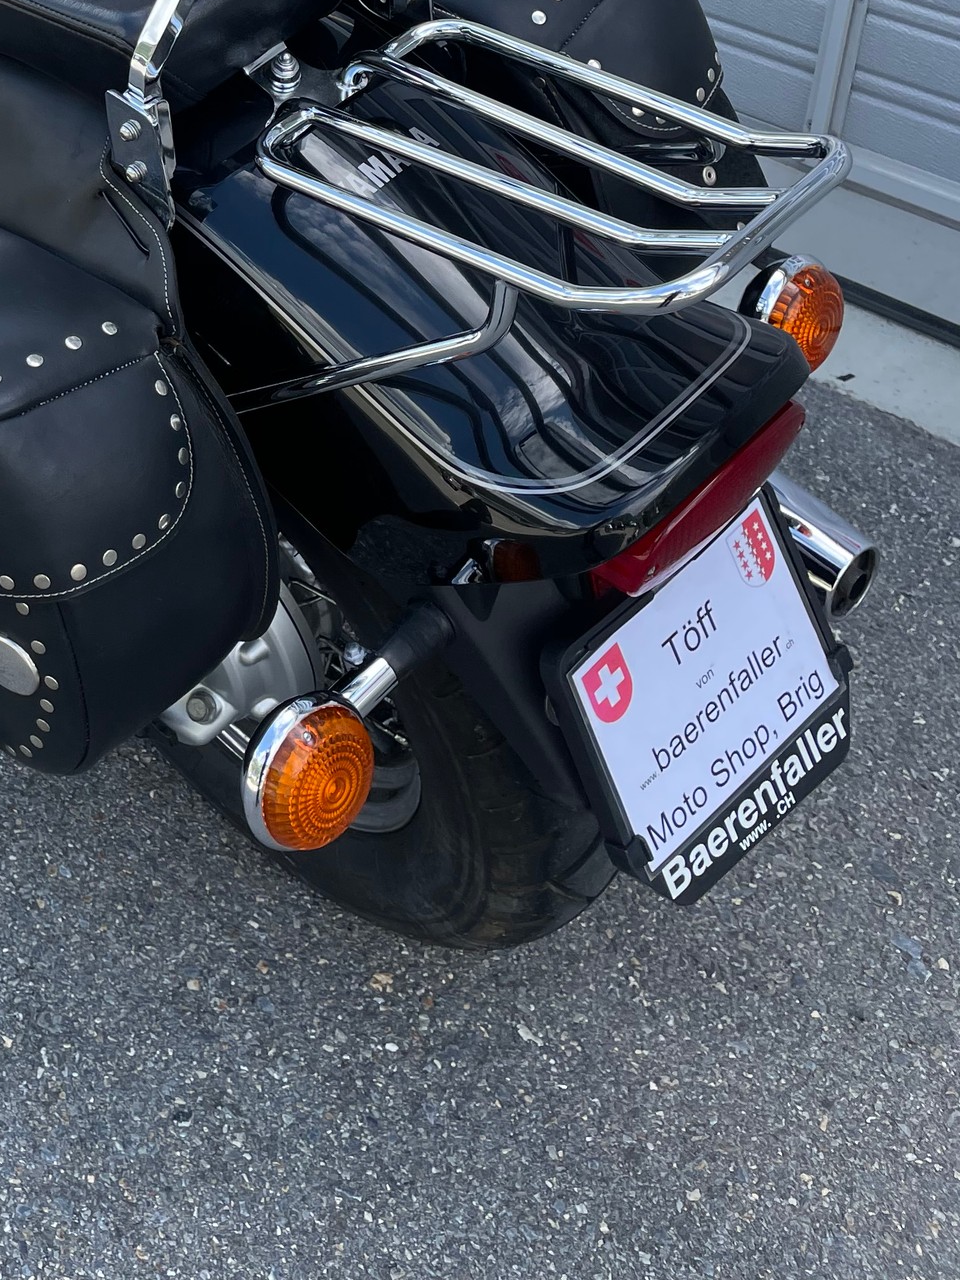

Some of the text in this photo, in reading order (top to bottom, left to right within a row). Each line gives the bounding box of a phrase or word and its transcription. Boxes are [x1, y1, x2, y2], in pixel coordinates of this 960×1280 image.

[338, 126, 440, 194] AMAA
[661, 599, 717, 665] Töff
[695, 668, 715, 689] von
[646, 669, 825, 851] Moto Shop, Brig
[661, 707, 847, 900] Baerenfaller
[738, 791, 796, 851] www. .CH
